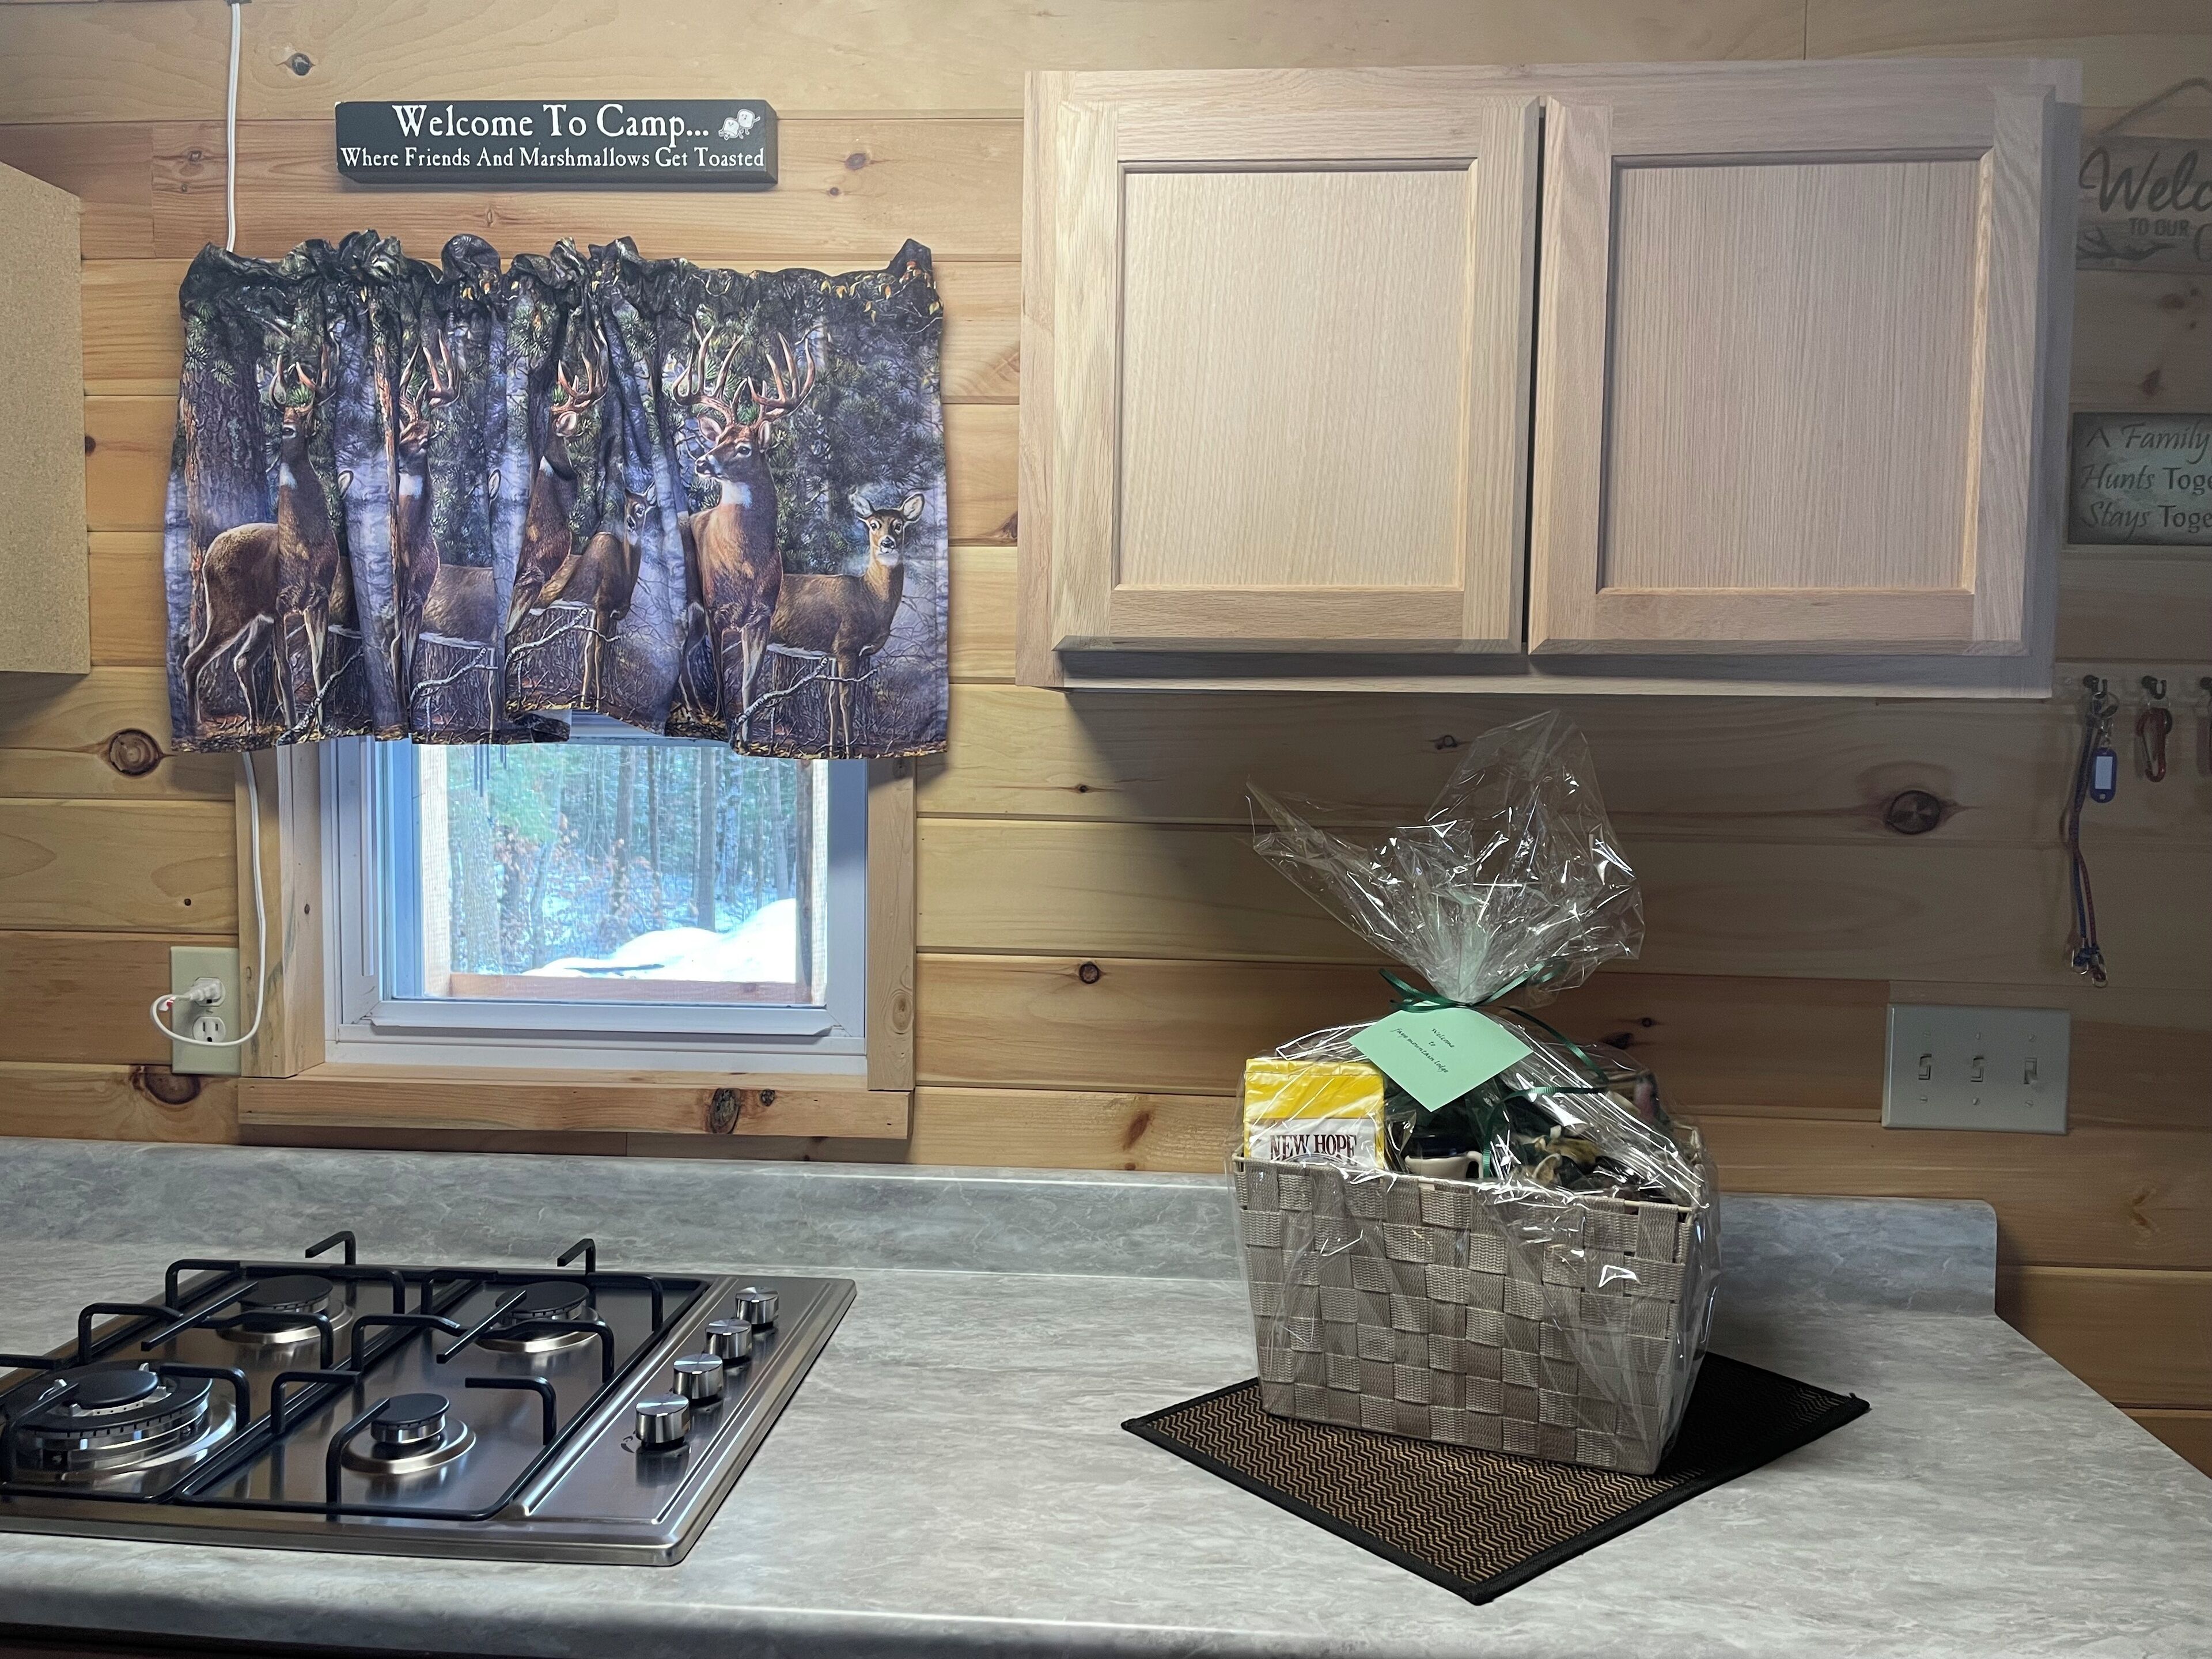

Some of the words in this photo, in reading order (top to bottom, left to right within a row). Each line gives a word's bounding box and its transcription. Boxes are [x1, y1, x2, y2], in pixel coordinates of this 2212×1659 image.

[392, 104, 533, 137] Welcome
[543, 104, 587, 137] To
[597, 104, 709, 148] Camp...
[340, 147, 399, 166] Where
[405, 146, 470, 166] Friends
[476, 147, 514, 166] And
[520, 147, 650, 166] Marshmallows
[655, 146, 688, 166] Get
[694, 146, 765, 166] Toasted
[2130, 218, 2149, 236] TO
[2154, 218, 2189, 237] OUR
[2086, 428, 2111, 448] A
[2122, 420, 2210, 464] Family
[2081, 461, 2156, 490] Hunts
[2082, 499, 2152, 541] Stays
[1432, 1028, 1454, 1047] Welcome
[1407, 1039, 1434, 1061] mountain
[1434, 1060, 1448, 1073] lodge
[1270, 1135, 1310, 1161] NEW
